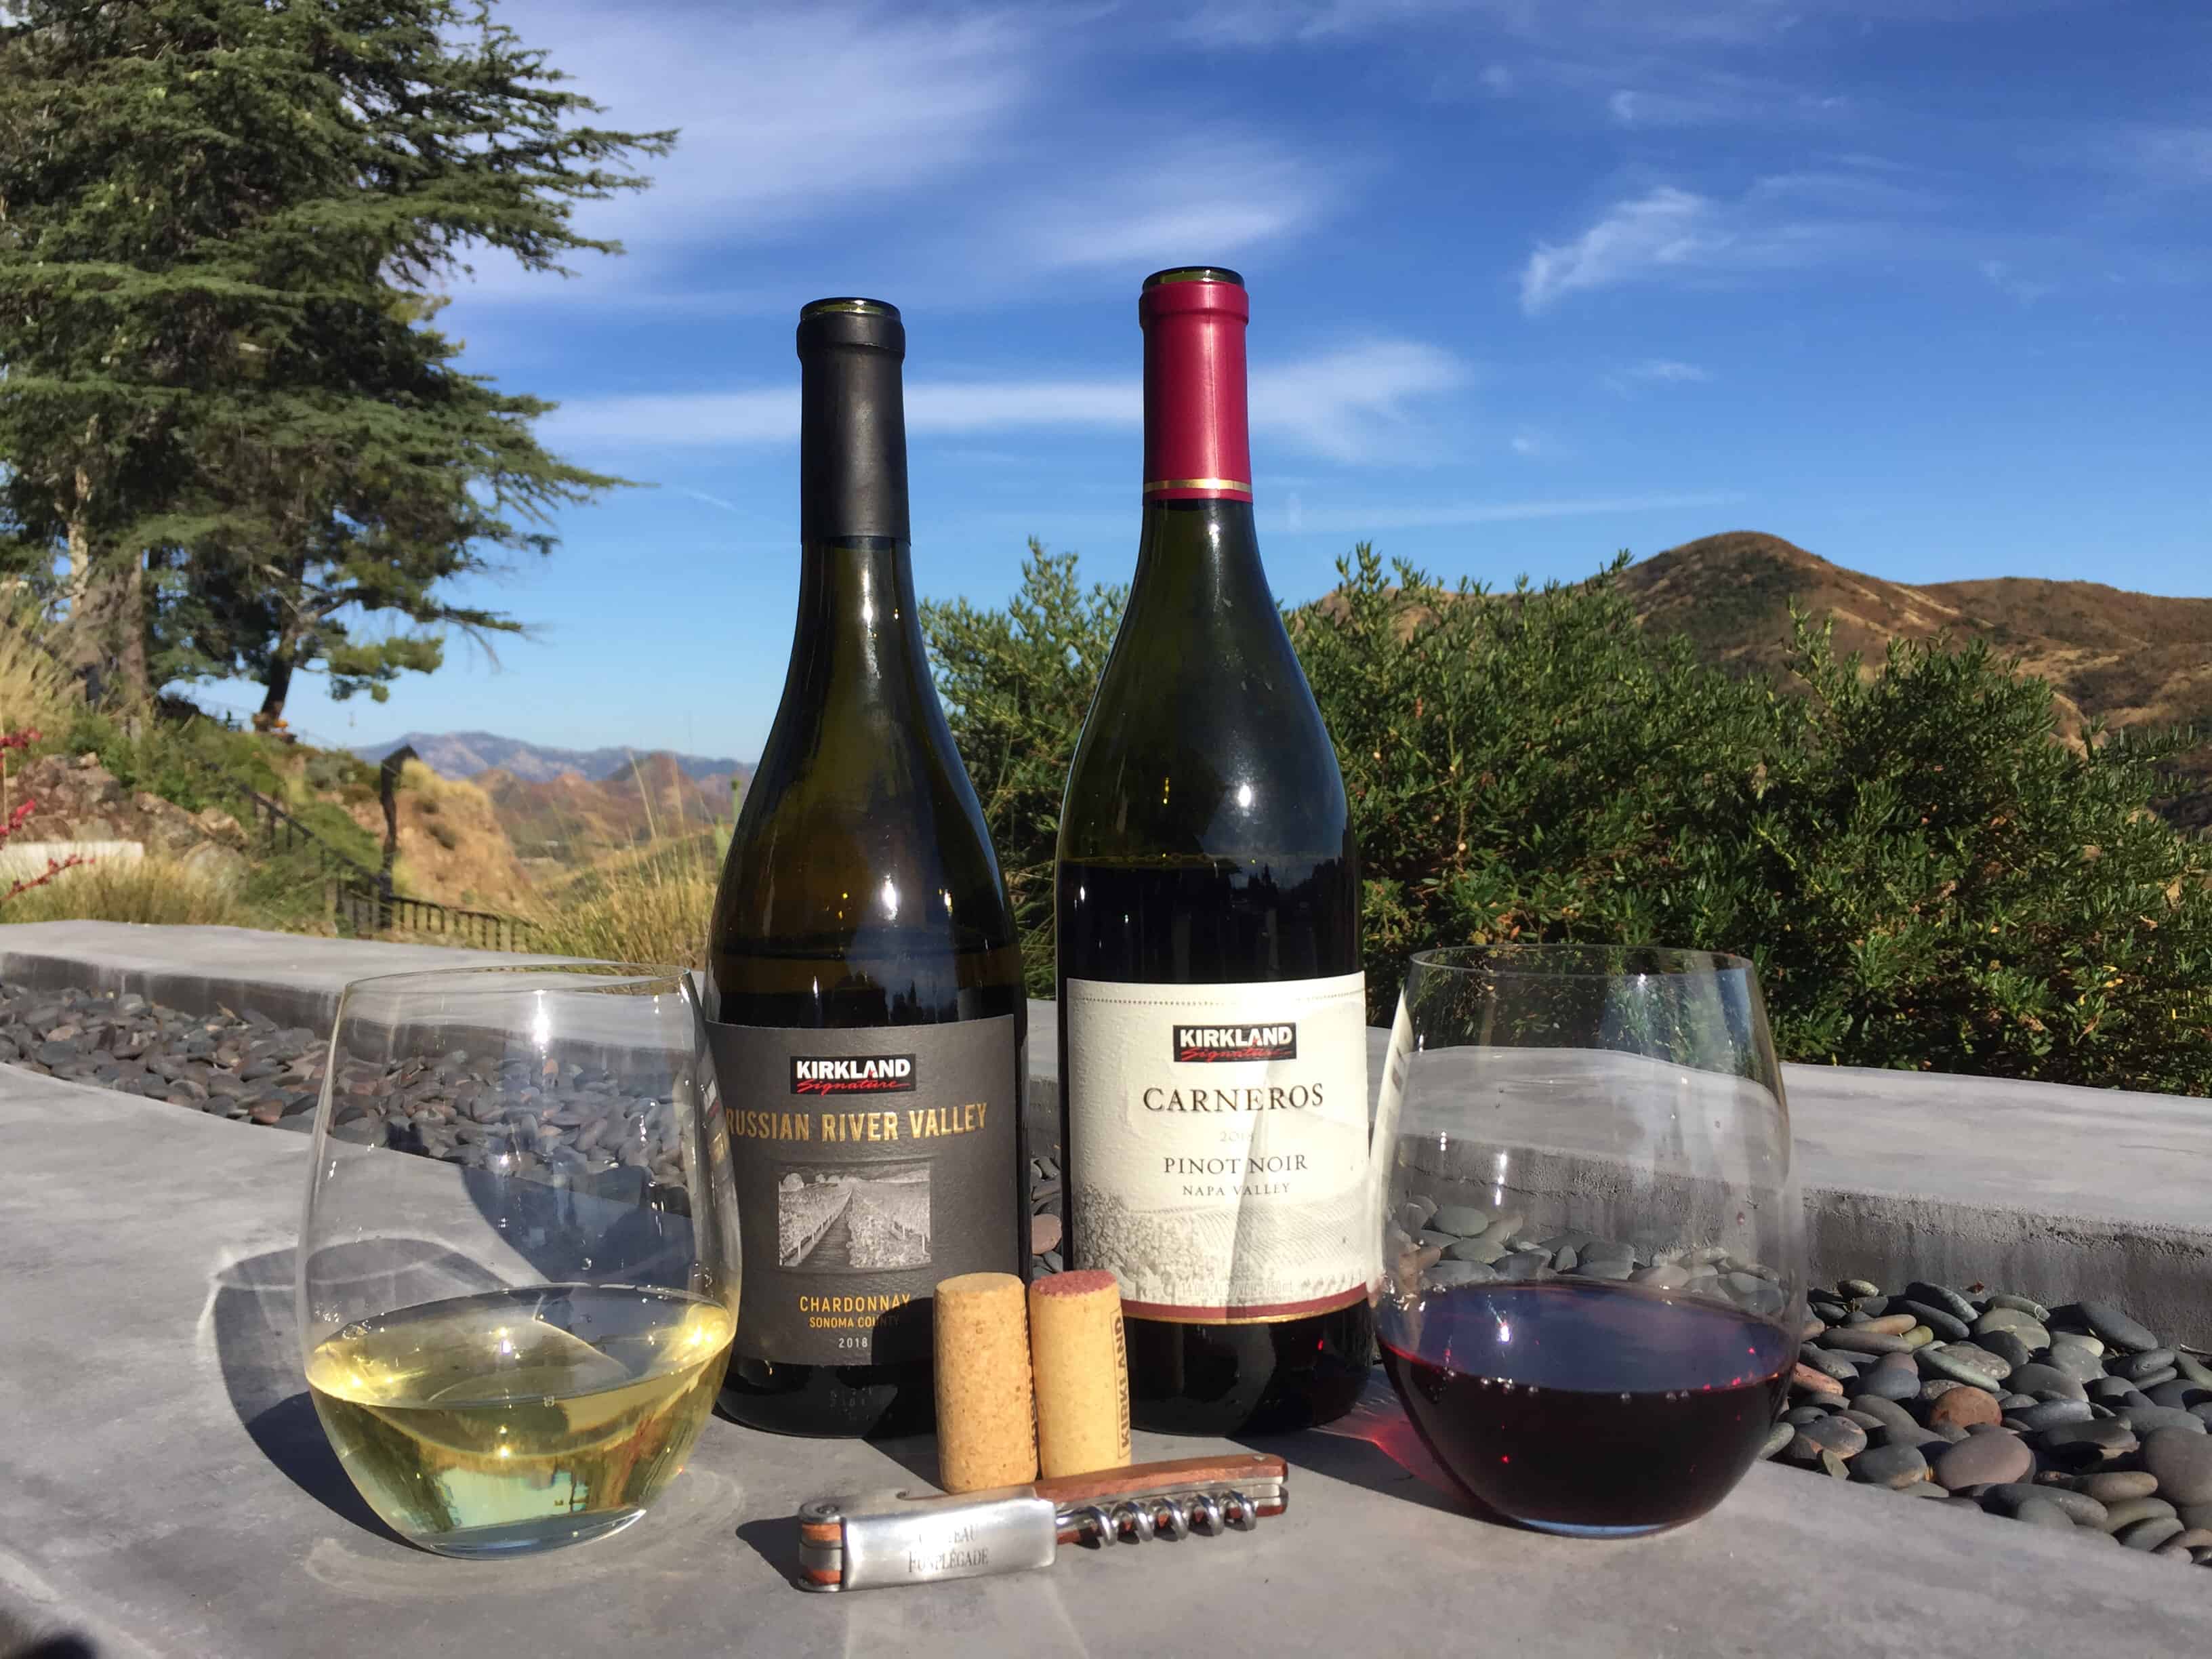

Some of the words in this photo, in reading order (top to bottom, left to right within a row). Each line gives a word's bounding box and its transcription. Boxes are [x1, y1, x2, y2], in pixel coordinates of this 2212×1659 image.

[1180, 1026, 1292, 1047] KIRKLAND
[796, 1059, 911, 1080] KIRKLAND
[796, 1078, 911, 1096] Signature
[1143, 1083, 1324, 1113] CARNEROS
[726, 1107, 809, 1140] RUSSIAN
[822, 1111, 898, 1142] RIVER
[909, 1103, 987, 1139] VALLEY
[1164, 1158, 1240, 1174] PINOT
[1248, 1154, 1308, 1173] NOIR
[1182, 1185, 1226, 1196] NAPA
[1233, 1183, 1292, 1195] VALLEY
[799, 1293, 911, 1313] CHARDONNAY
[809, 1316, 854, 1329] SONOMA
[838, 1338, 868, 1349] 2018
[1114, 1317, 1129, 1448] KIRKLAND
